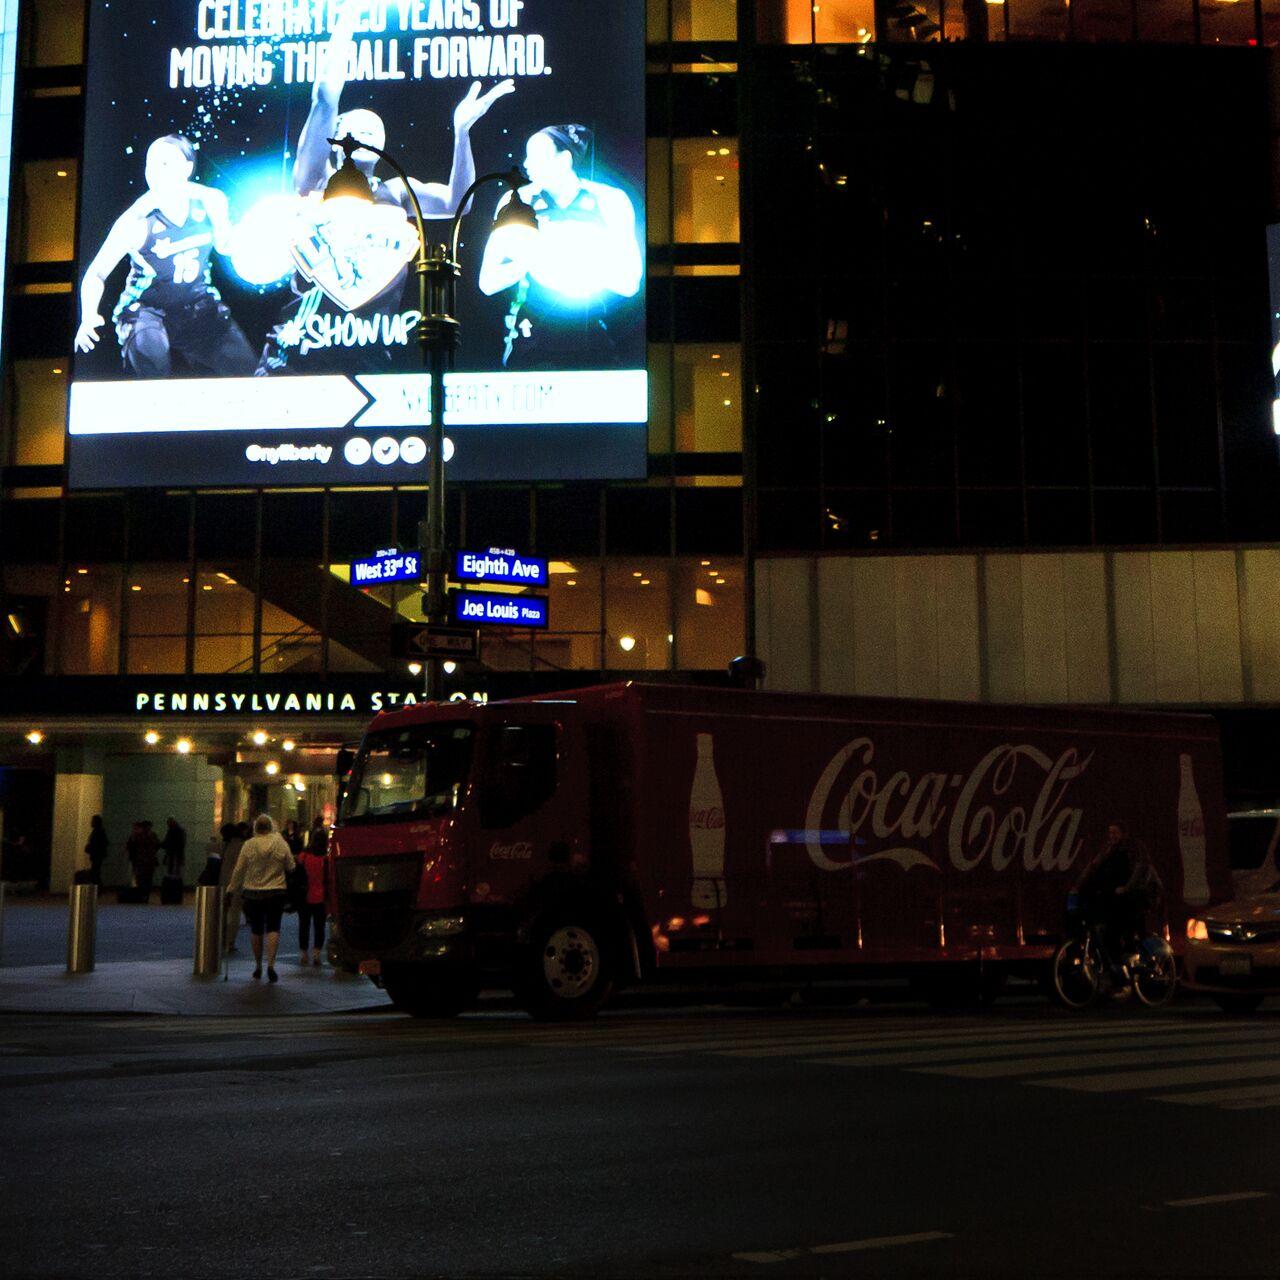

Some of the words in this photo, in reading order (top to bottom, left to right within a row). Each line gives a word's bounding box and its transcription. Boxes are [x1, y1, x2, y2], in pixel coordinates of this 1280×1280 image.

[169, 43, 274, 88] MOVING
[413, 34, 552, 79] FORWARD.
[355, 563, 382, 581] West
[404, 556, 417, 574] St
[463, 555, 509, 578] Eighth
[511, 559, 540, 579] Ave
[463, 599, 484, 617] Joe
[487, 599, 519, 619] Louis
[521, 607, 541, 619] Plaza
[136, 692, 356, 711] PENNSYLVANIA
[804, 736, 1097, 871] Coca-Cola
